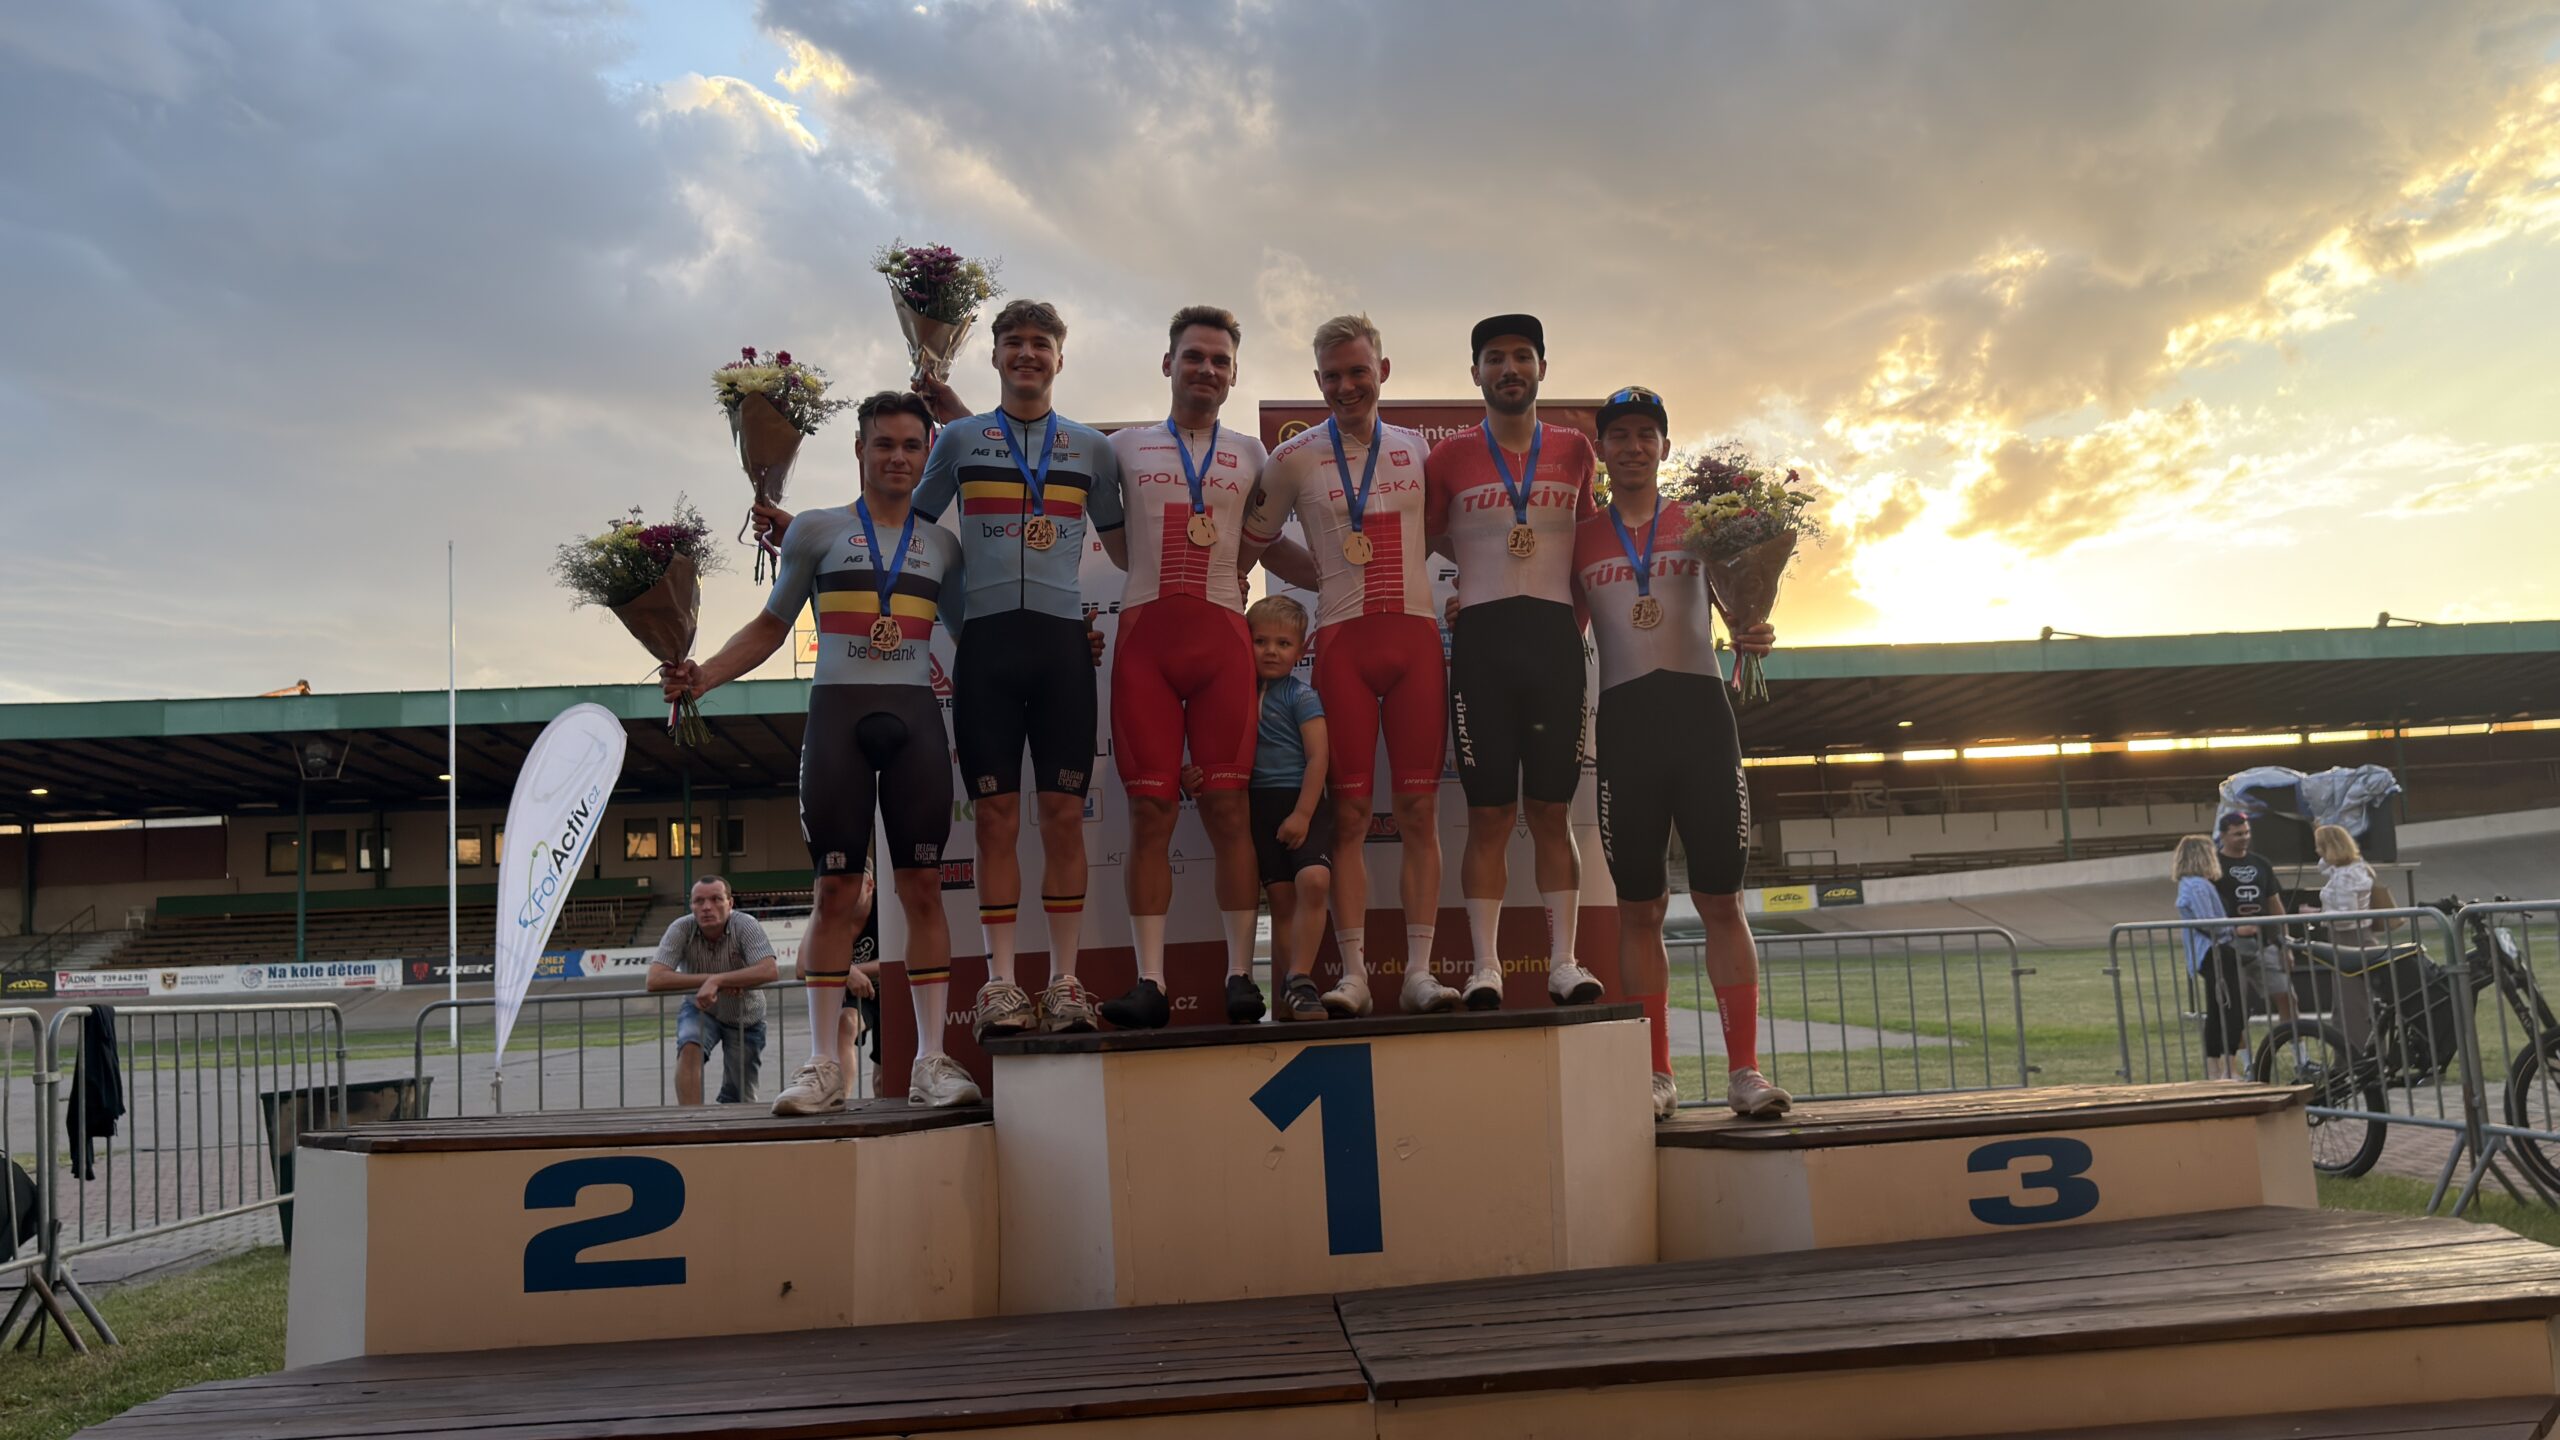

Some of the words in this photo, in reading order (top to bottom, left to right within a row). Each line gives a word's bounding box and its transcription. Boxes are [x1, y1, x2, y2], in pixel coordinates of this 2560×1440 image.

[1276, 433, 1318, 461] POLSKA
[1328, 480, 1420, 501] PSKA
[1454, 691, 1476, 768] TÜRKİYE
[1600, 779, 1615, 863] TÜRKİYE
[1735, 766, 1748, 851] TÜRKİYE
[268, 966, 287, 979] Na
[291, 964, 323, 978] kole
[327, 963, 377, 977] dětem
[1249, 1043, 1383, 1256] 1
[1967, 1137, 2099, 1225] 3
[524, 1156, 686, 1293] 2
